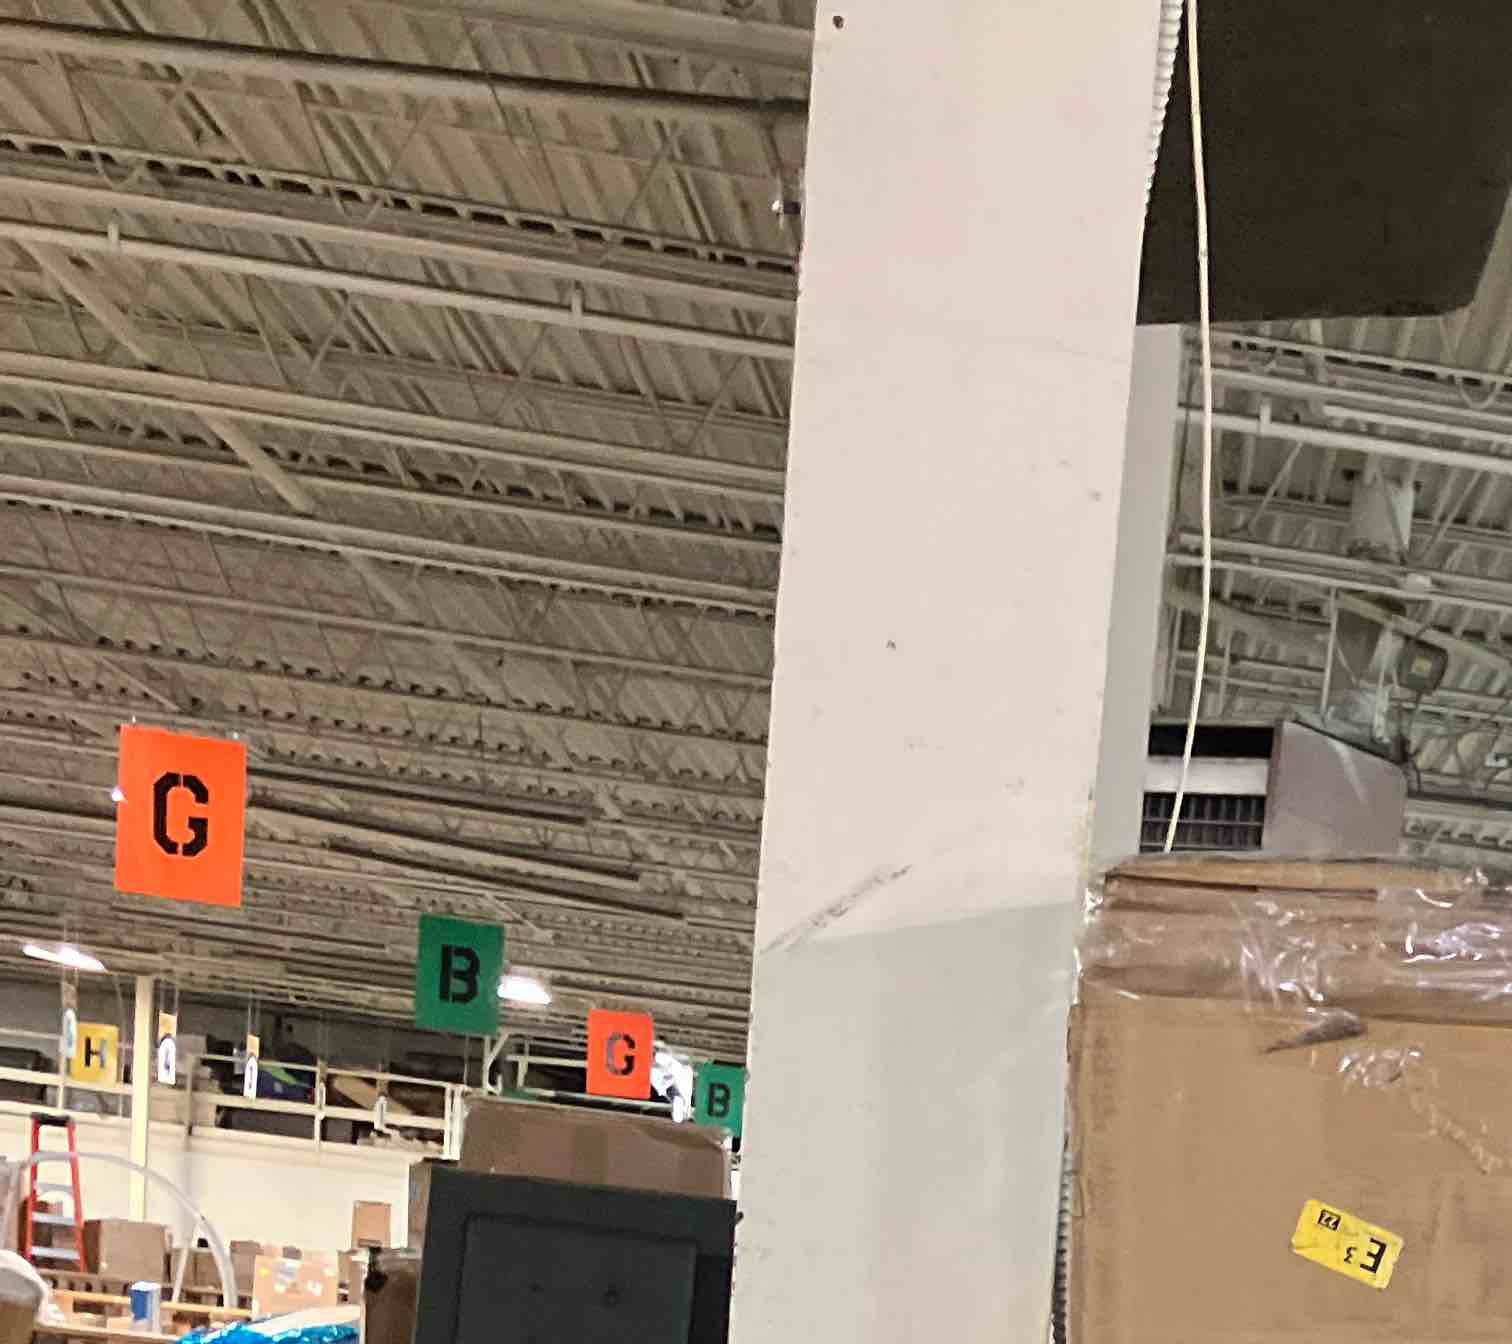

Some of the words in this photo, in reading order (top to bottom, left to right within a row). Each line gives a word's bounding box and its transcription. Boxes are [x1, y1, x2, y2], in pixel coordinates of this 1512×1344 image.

[153, 772, 209, 857] G
[439, 945, 481, 1004] B
[84, 1035, 107, 1073] H
[604, 1033, 636, 1077] G
[704, 1082, 731, 1119] B
